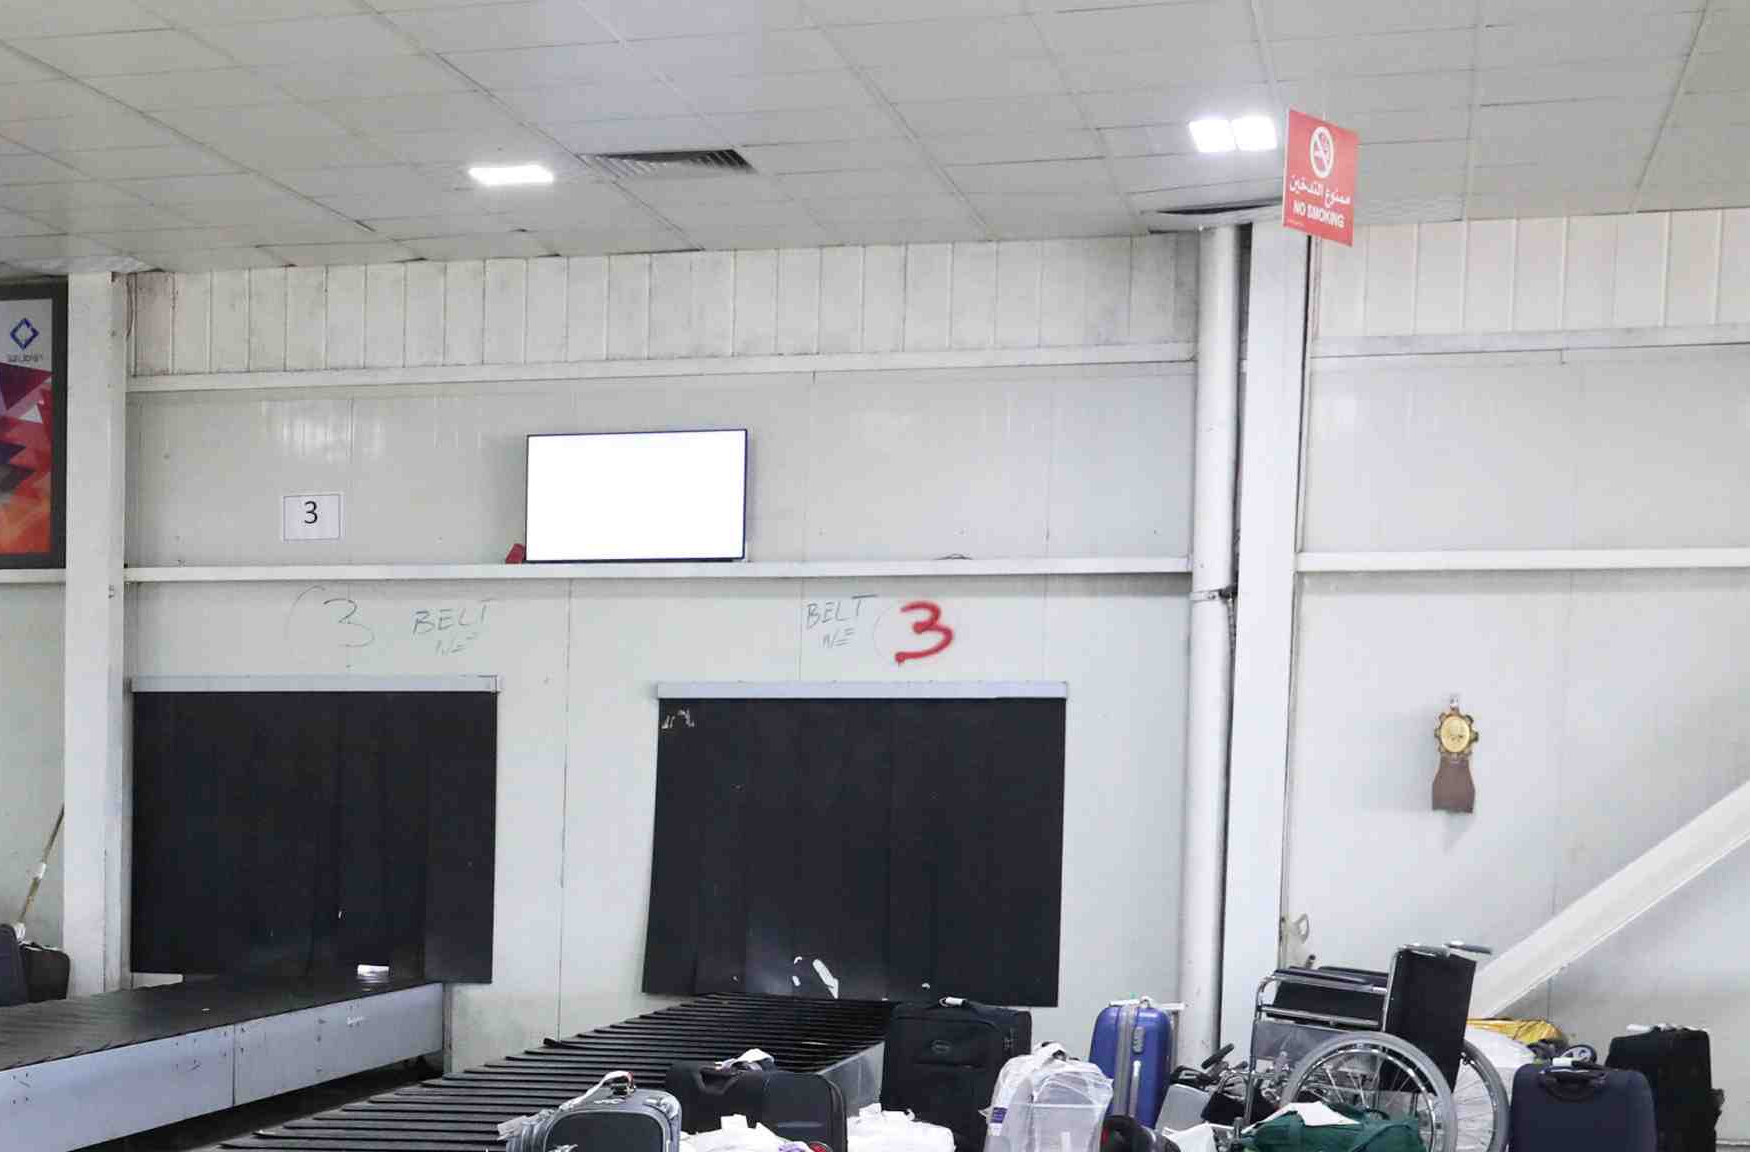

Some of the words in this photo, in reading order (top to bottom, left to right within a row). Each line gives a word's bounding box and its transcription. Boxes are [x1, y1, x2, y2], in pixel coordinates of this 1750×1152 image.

[1292, 199, 1307, 217] NO
[1306, 203, 1346, 229] SMOKING
[304, 500, 318, 525] 3
[411, 597, 497, 636] BELT
[806, 593, 879, 631] BELT
[894, 600, 955, 665] 3
